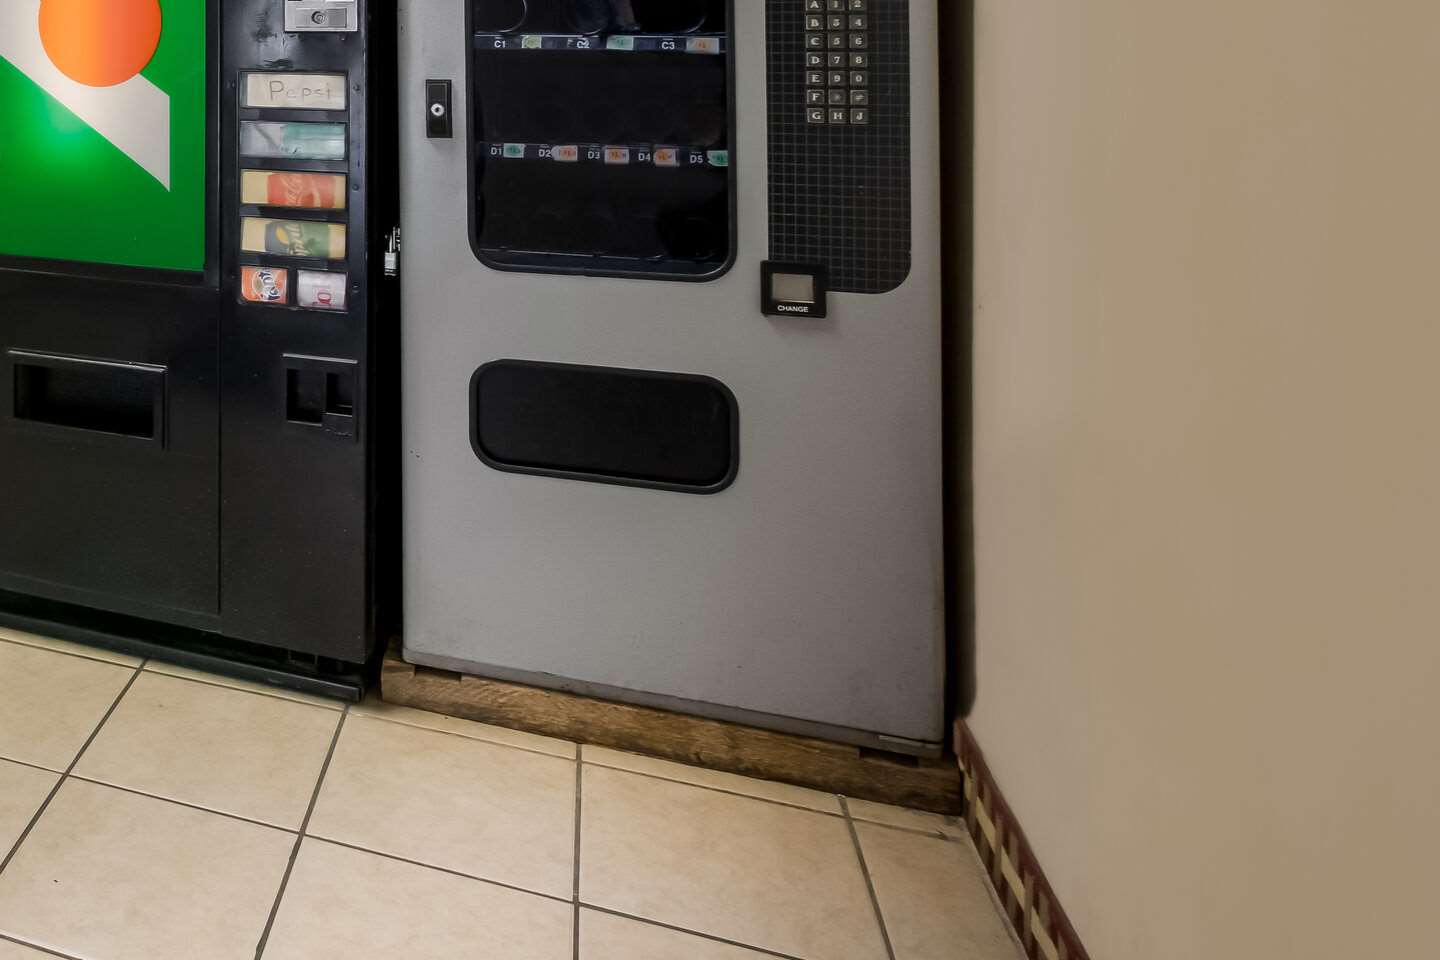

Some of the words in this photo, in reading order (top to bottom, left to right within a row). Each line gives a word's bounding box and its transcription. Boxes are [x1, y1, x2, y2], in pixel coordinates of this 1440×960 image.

[494, 40, 506, 49] C1
[661, 41, 675, 50] C3
[490, 147, 502, 156] D1
[538, 149, 551, 158] D2
[587, 151, 600, 160] D3
[638, 152, 651, 162] D4
[689, 155, 704, 164] D5
[777, 305, 809, 313] CHANGE
